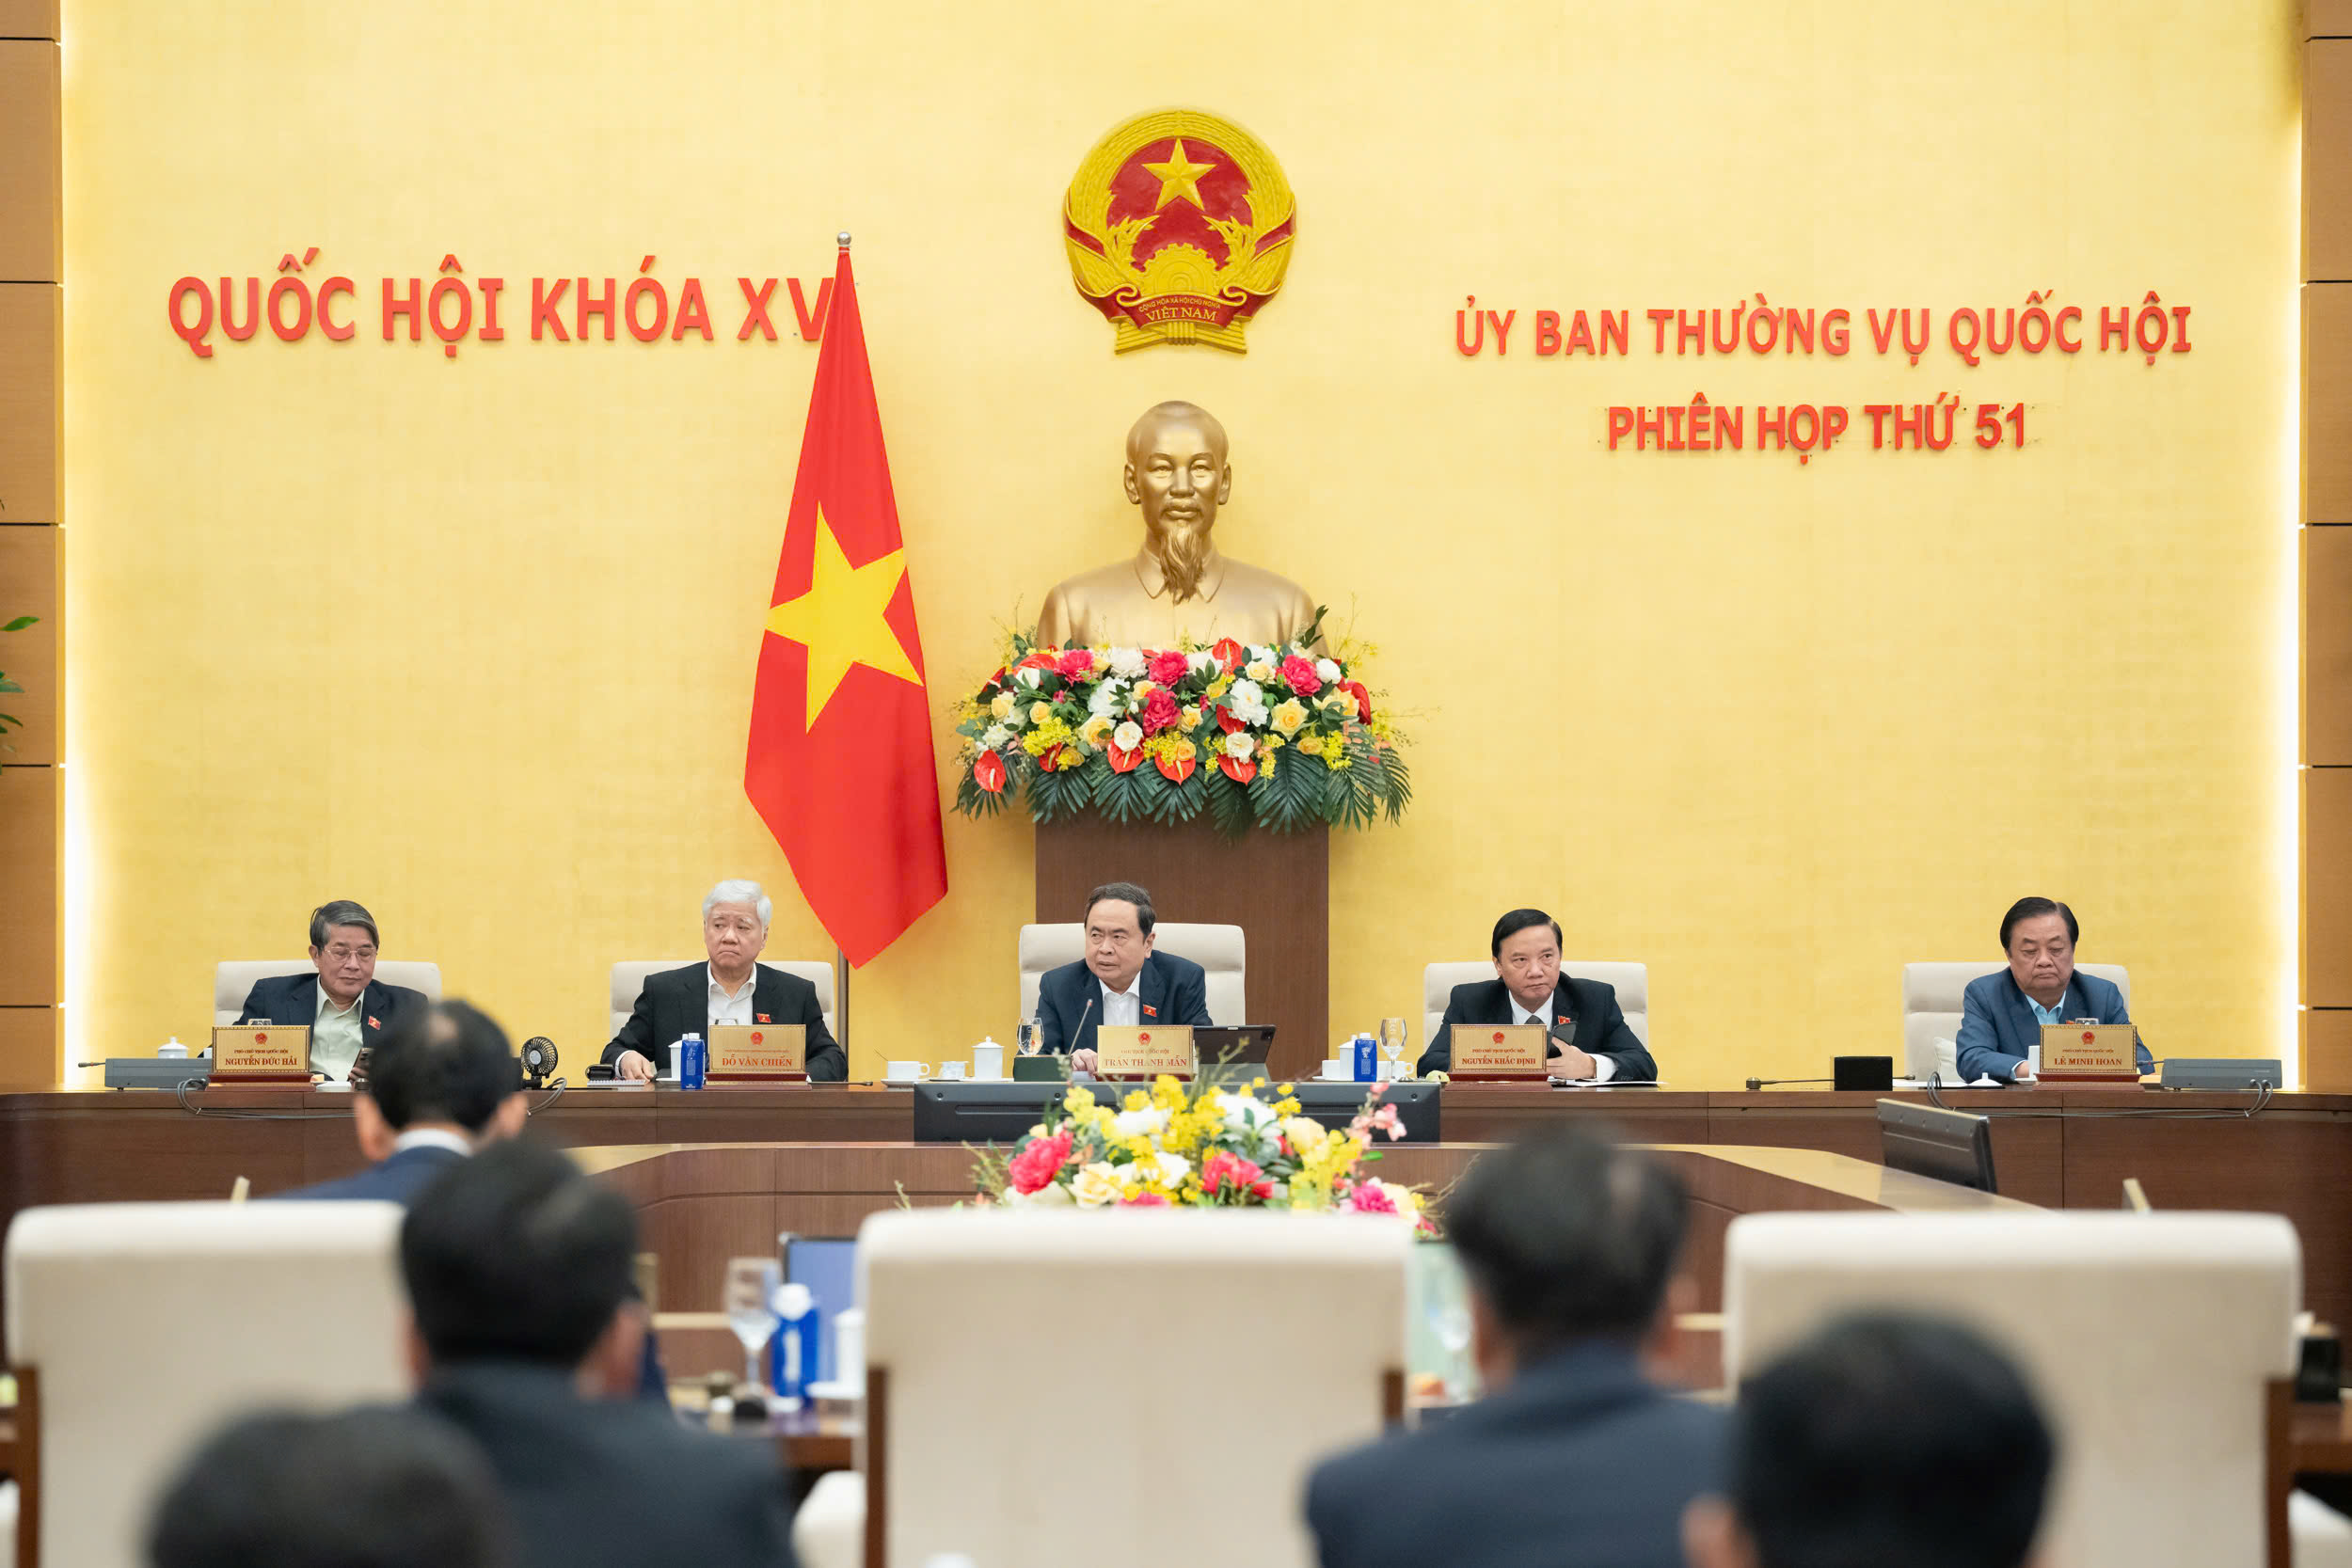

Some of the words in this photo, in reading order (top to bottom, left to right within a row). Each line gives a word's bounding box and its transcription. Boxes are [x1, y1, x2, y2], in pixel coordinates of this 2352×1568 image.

[169, 248, 355, 356] QUỐC
[382, 254, 504, 356] HỘI
[531, 256, 713, 341] KHÓA
[737, 277, 834, 341] XV
[1181, 307, 1217, 321] NAM
[1455, 295, 1517, 356] ỦY
[1535, 310, 1629, 356] BAN
[1647, 293, 1851, 356] THƯỜNG
[1867, 309, 1931, 365] VỤ
[1948, 290, 2083, 366] QUỐC
[2100, 291, 2192, 365] HỘI
[1608, 392, 1743, 450] PHIÊN
[1756, 404, 1849, 464] HỌP
[1864, 392, 1960, 450] THỨ
[1975, 403, 2025, 449] 51
[225, 1054, 261, 1065] NGUYỄN
[262, 1056, 280, 1065] ĐỨC
[281, 1055, 298, 1065] HẢI
[723, 1053, 737, 1066] ĐỖ
[739, 1056, 758, 1066] VĂN
[761, 1054, 792, 1067] CHIẾN
[1461, 1055, 1492, 1064] NGUYỄN
[1494, 1055, 1516, 1064] KHẮC
[2054, 1055, 2066, 1065] LÊ
